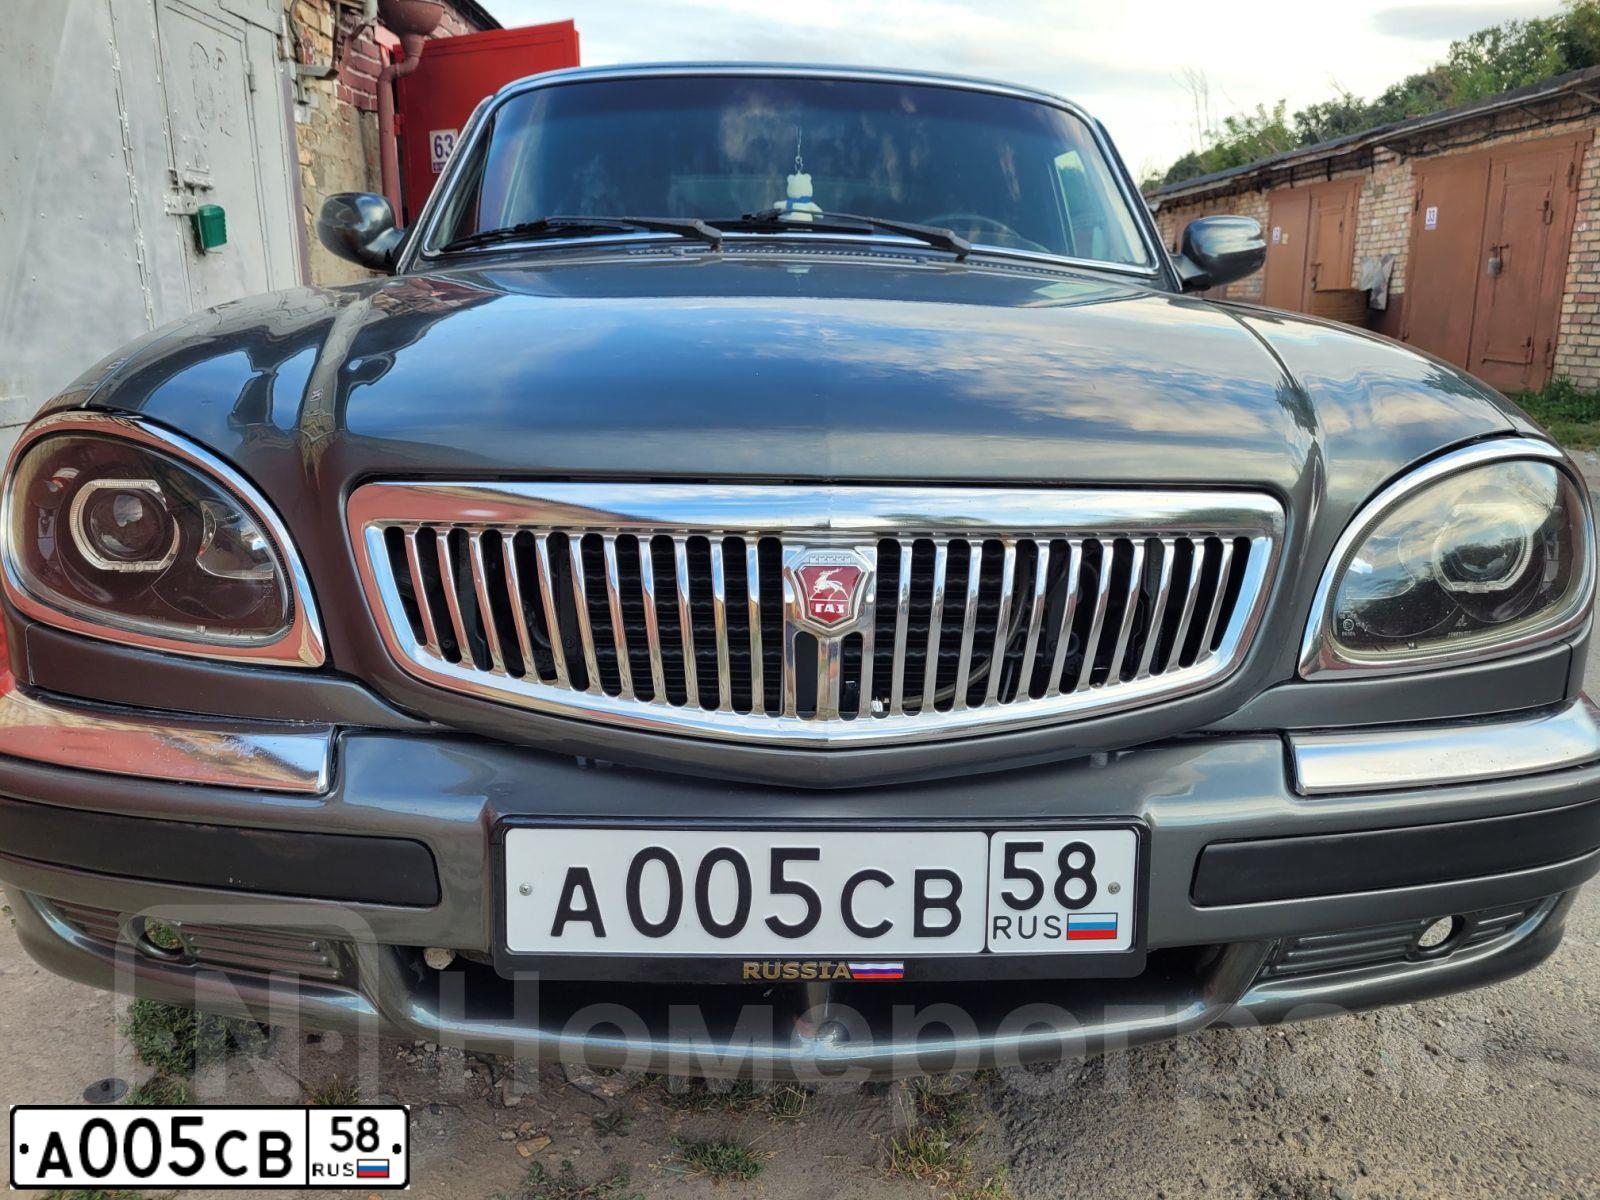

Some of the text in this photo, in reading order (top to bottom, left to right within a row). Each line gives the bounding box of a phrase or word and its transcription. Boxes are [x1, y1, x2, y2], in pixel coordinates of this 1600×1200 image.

[434, 134, 454, 159] 63
[815, 603, 845, 613] ГАЗ
[1001, 841, 1097, 910] 58
[992, 915, 1062, 939] RUS
[743, 961, 851, 980] RUSSIA
